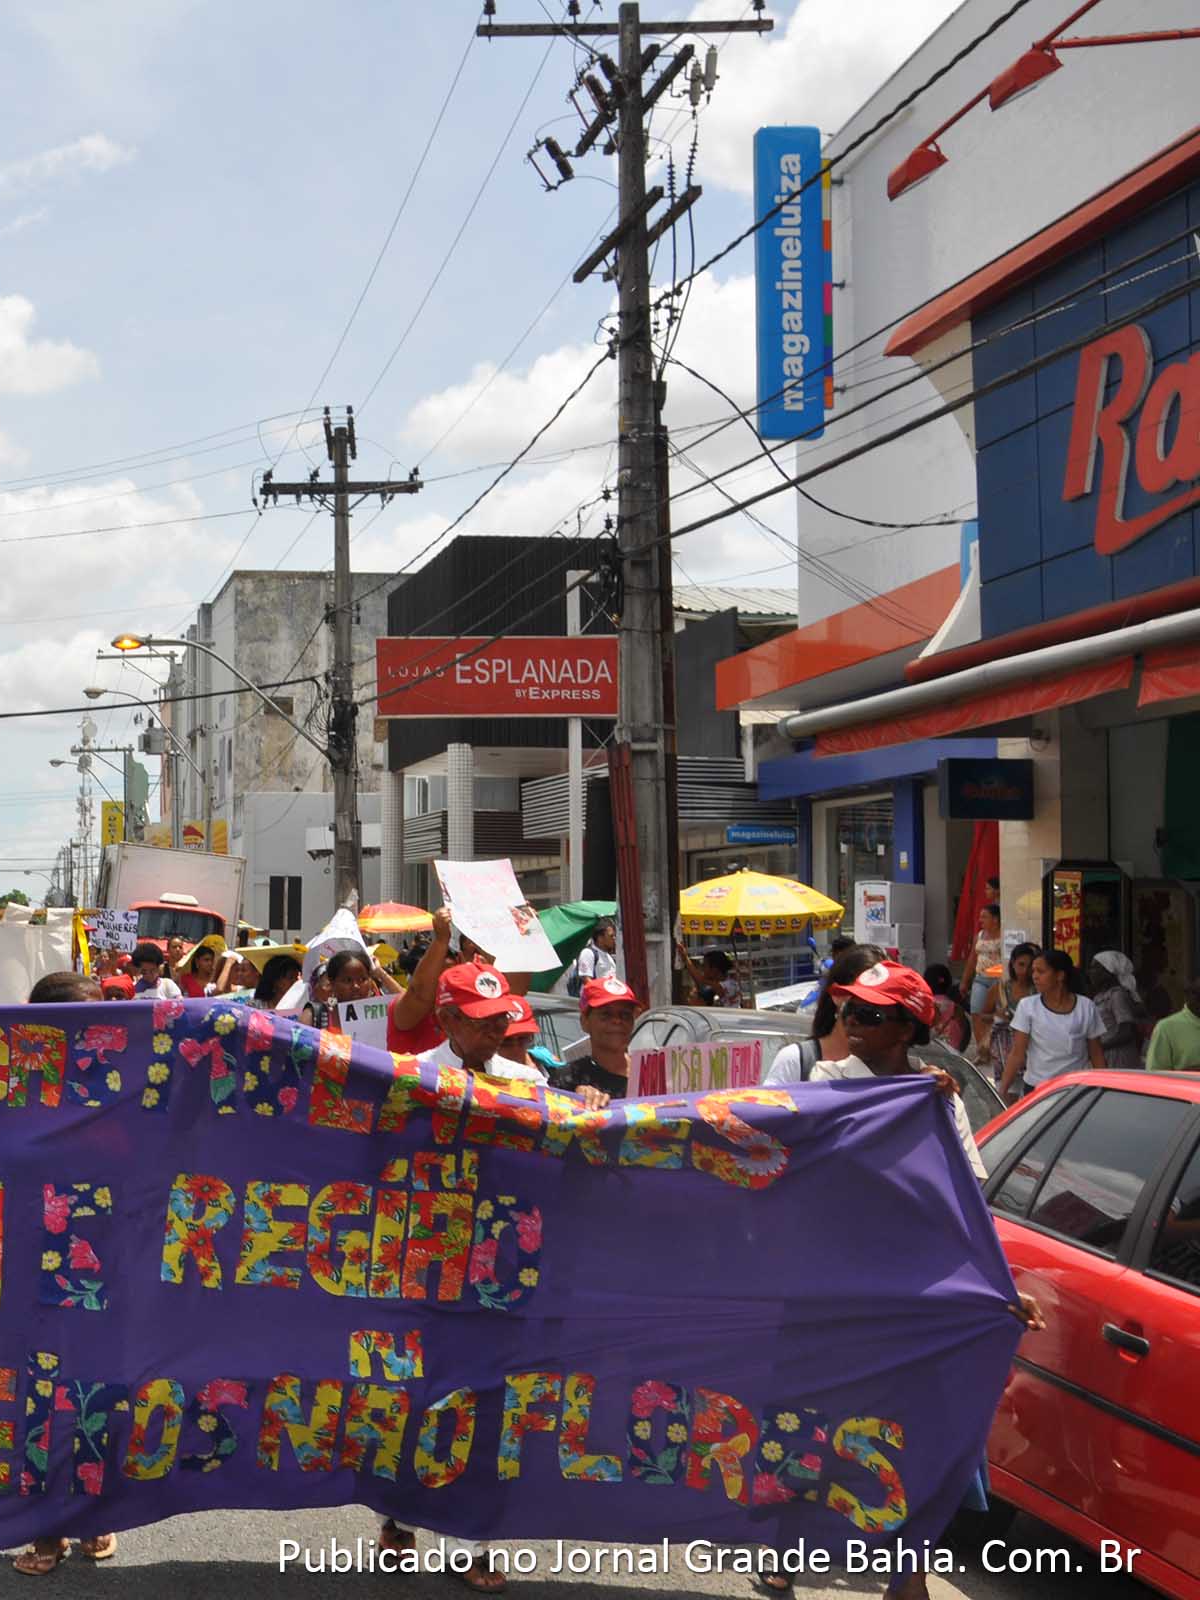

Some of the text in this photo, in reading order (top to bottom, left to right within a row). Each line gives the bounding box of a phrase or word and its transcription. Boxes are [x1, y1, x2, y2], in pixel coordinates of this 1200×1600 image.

[774, 153, 811, 412] magazineluiza
[455, 652, 613, 685] ESPLANADA
[515, 686, 602, 701] BY EXPRESS
[345, 1003, 358, 1022] A
[40, 1182, 114, 1312] E
[160, 1147, 545, 1313] REGIÃO
[256, 1328, 479, 1490] NÃO
[497, 1371, 909, 1534] FLORES
